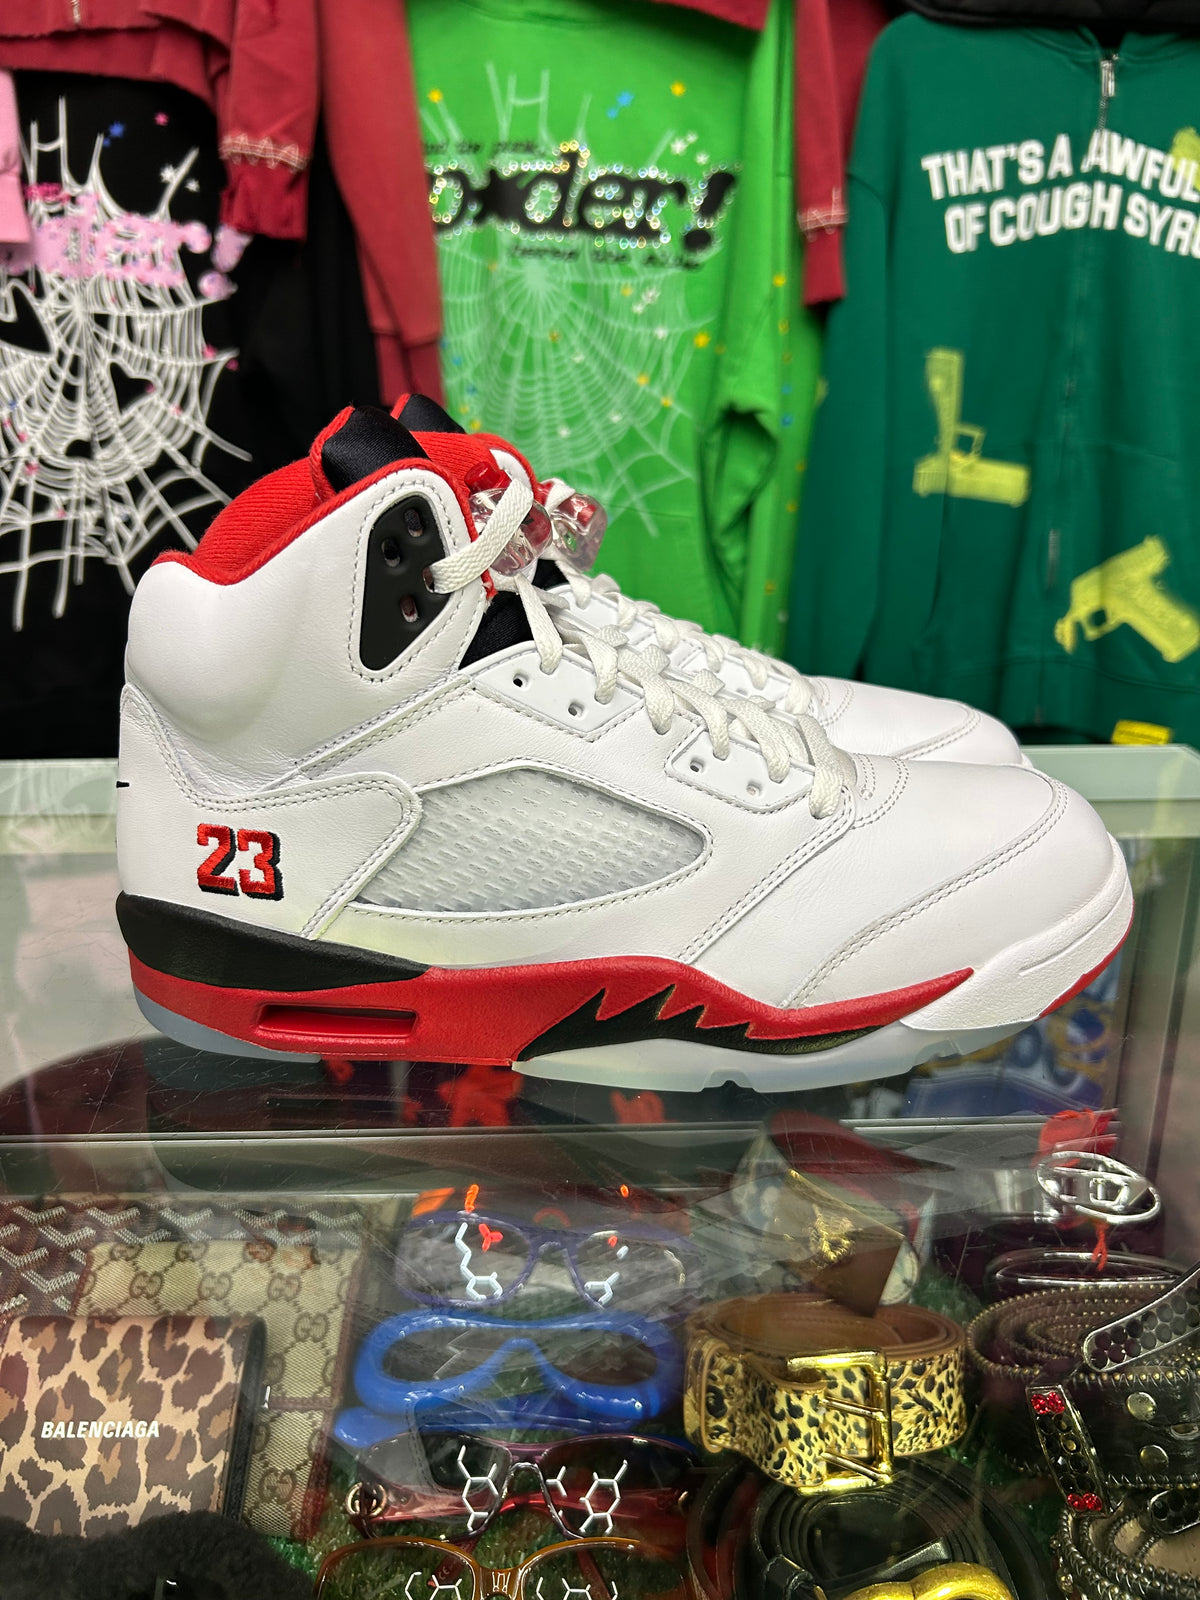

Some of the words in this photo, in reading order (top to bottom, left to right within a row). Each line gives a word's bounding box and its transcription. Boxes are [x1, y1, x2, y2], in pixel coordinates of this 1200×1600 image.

[921, 139, 1044, 200] THAT'S
[1047, 133, 1073, 180] A
[1080, 128, 1200, 203] AWFUL
[944, 204, 986, 254] OF
[989, 180, 1123, 247] COUGH
[197, 823, 284, 901] 23
[41, 1421, 160, 1439] BALENCIAGA
